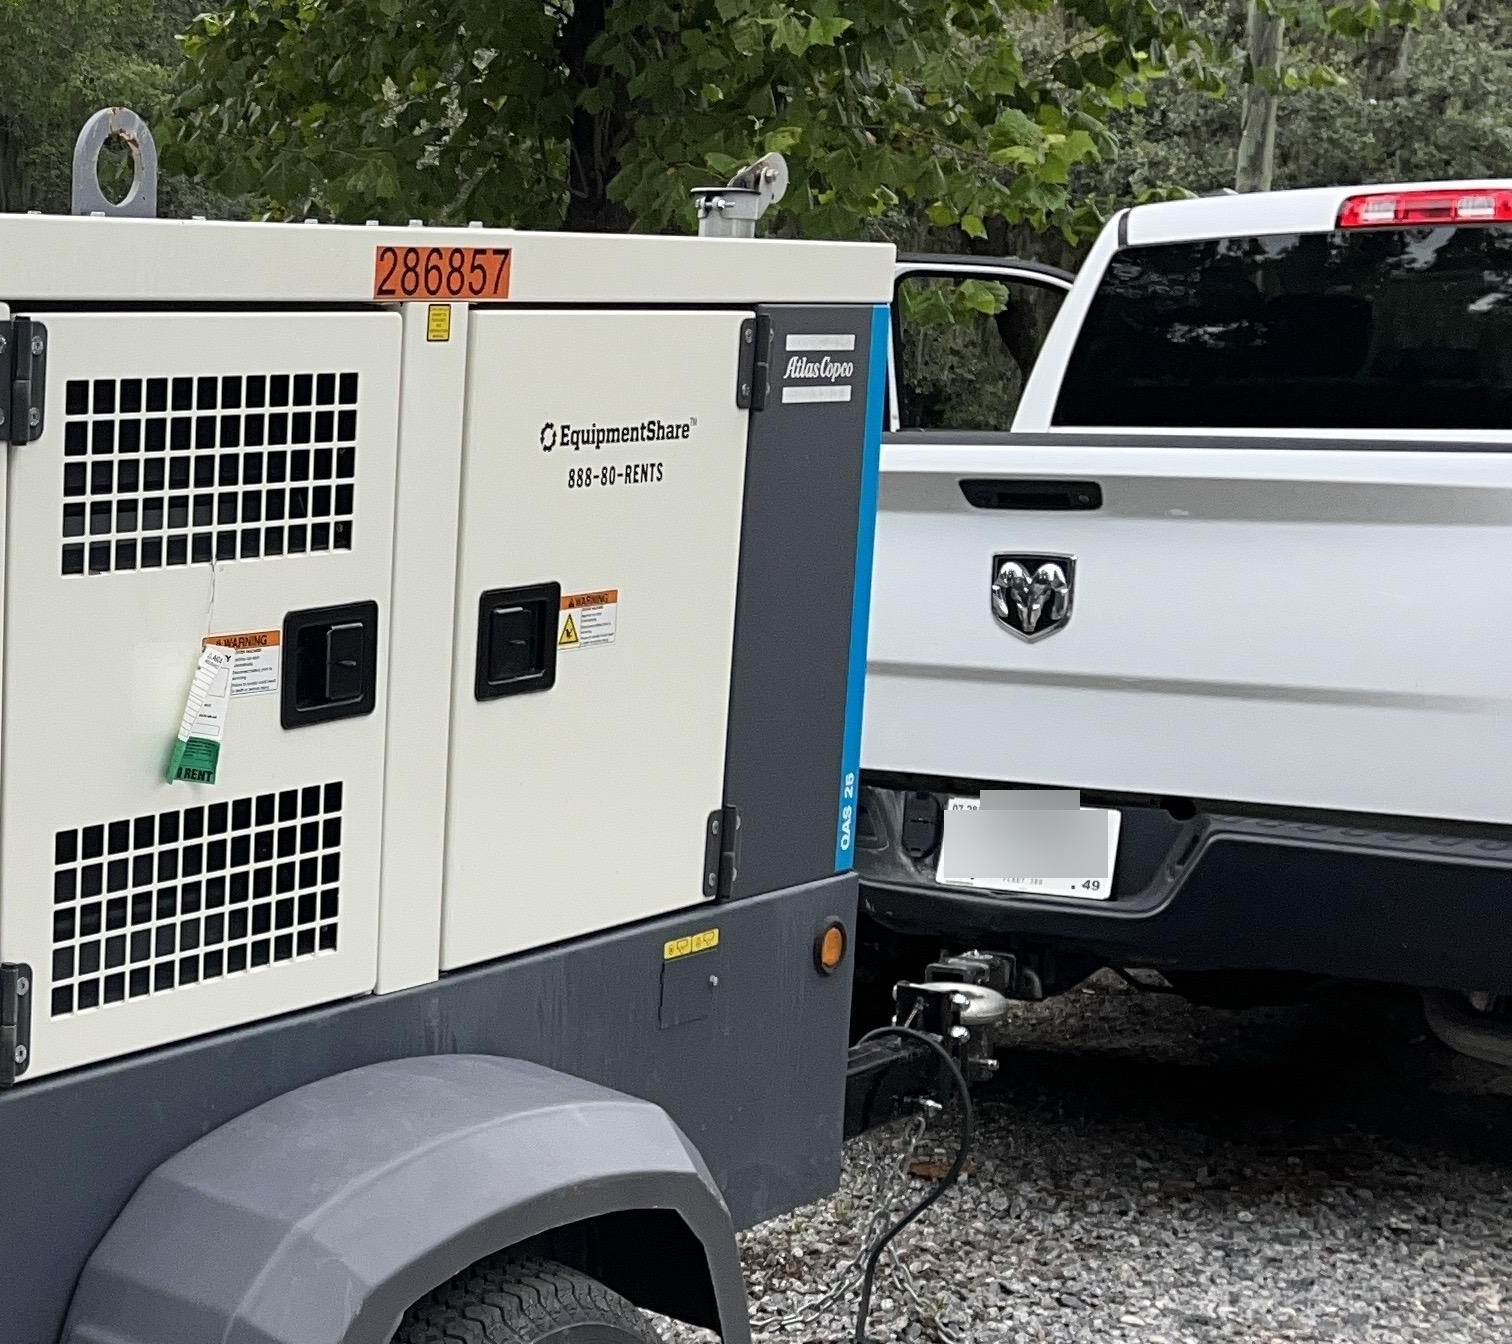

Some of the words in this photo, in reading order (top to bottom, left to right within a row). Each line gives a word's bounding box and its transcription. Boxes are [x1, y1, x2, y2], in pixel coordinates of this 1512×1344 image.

[377, 247, 510, 295] 286857
[783, 356, 821, 379] Atlas
[820, 356, 854, 383] Copco
[559, 419, 691, 451] EquipmentShare
[567, 462, 664, 489] 888-80-RENTS
[224, 634, 269, 649] WARNING
[183, 767, 214, 783] RENT
[1081, 879, 1101, 892] 49
